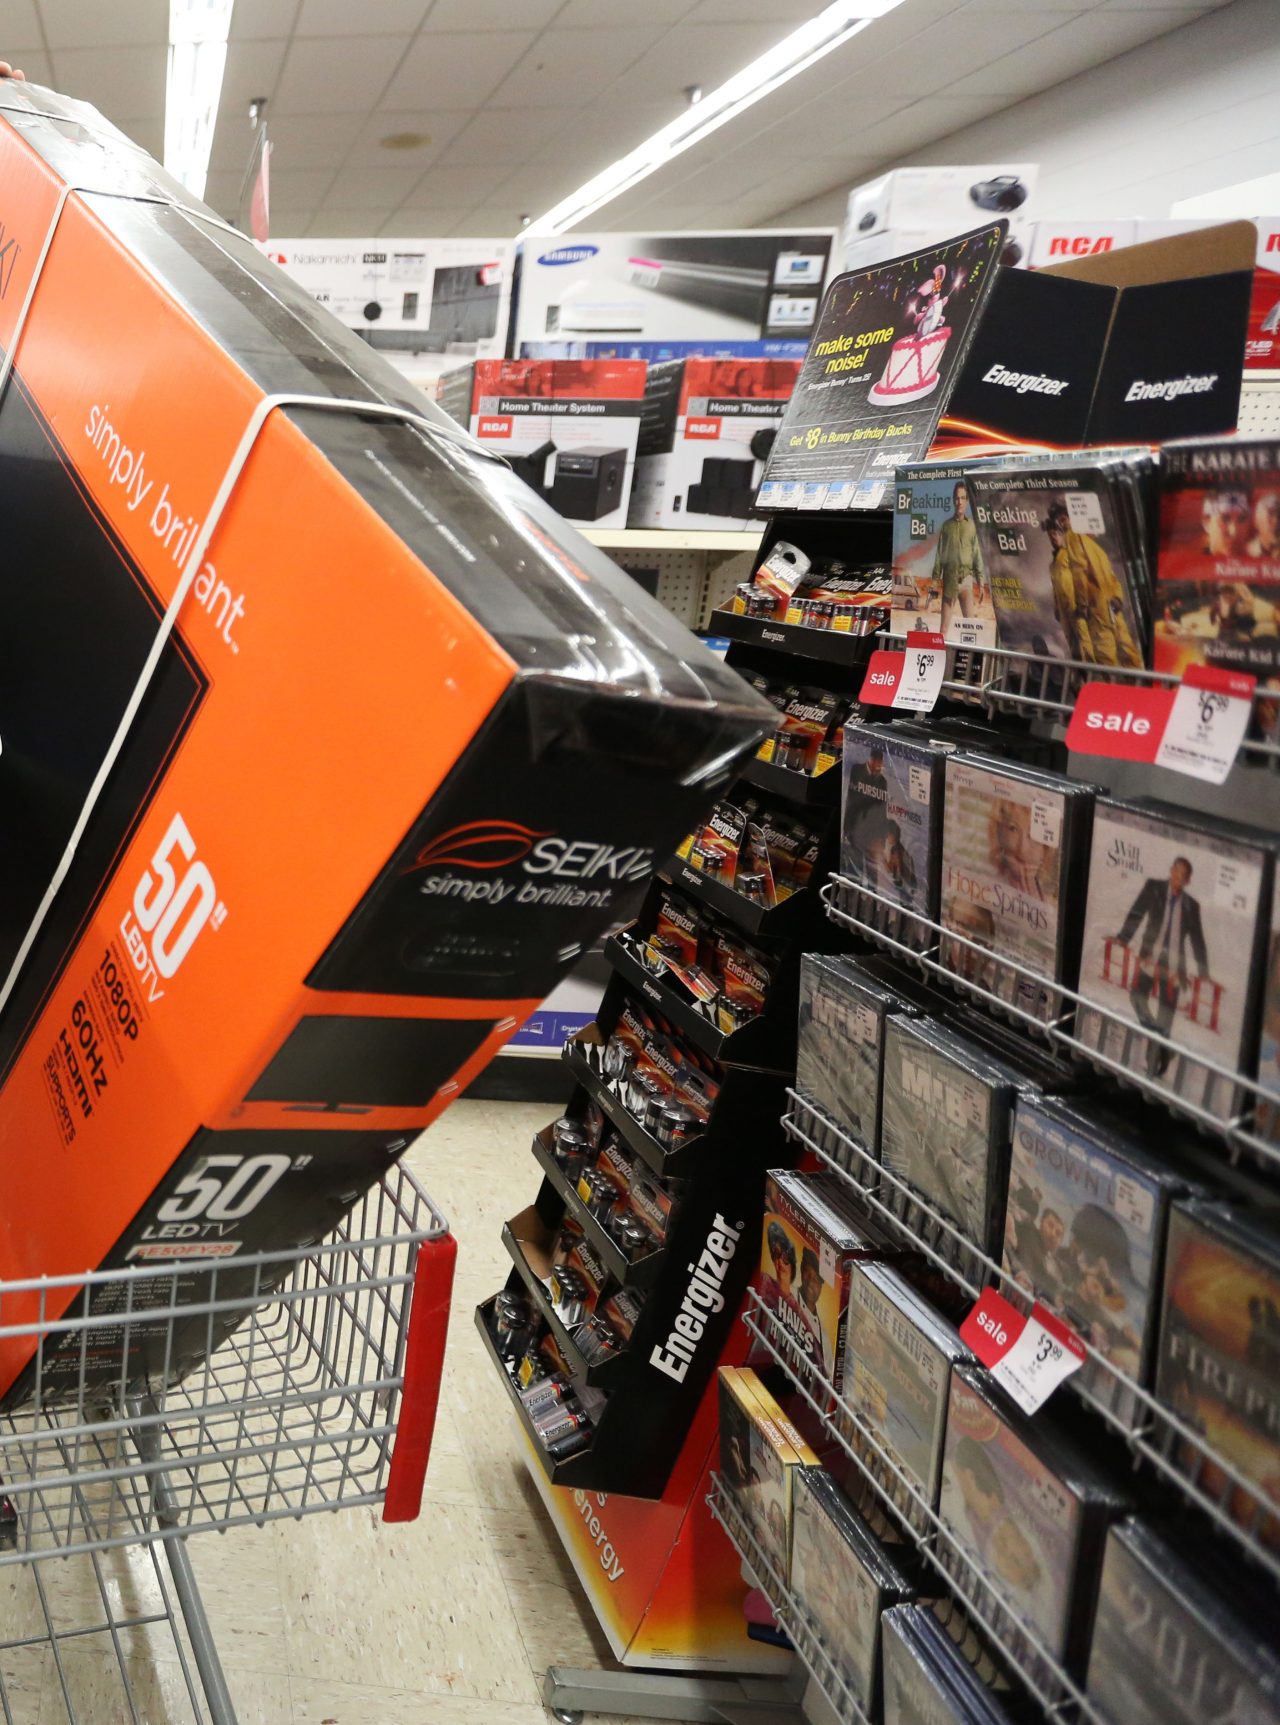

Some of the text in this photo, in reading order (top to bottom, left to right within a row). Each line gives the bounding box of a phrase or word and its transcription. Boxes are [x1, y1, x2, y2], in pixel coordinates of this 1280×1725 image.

[545, 248, 593, 261] SAMSUNG
[1049, 237, 1114, 255] RCA
[293, 253, 357, 264] Nakamichi
[815, 333, 853, 357] make
[853, 326, 895, 348] some
[825, 348, 870, 374] noise!
[982, 363, 1069, 396] Energizer
[1124, 373, 1218, 402] Energizer
[501, 402, 606, 414] Home Theater System
[710, 403, 779, 413] Home Theater
[481, 422, 509, 433] RCA
[688, 423, 717, 434] RCA
[790, 424, 913, 449] Get $8 in Bunny Birthday Bucks
[872, 450, 913, 469] Energizer
[1192, 451, 1269, 472] KARATE
[908, 470, 962, 481] The Complete First
[975, 479, 1079, 492] The Complete Third Season
[898, 492, 951, 512] Breaking
[84, 404, 245, 645] simply brilant
[911, 519, 935, 535] Bad
[977, 506, 1040, 528] Breaking
[998, 534, 1027, 552] Bad
[766, 553, 801, 584] Energizer
[822, 577, 866, 591] Energizer
[863, 576, 892, 594] Energ
[761, 628, 786, 643] Energizer
[870, 671, 896, 686] sale
[785, 699, 830, 722] Energizer
[1086, 711, 1151, 735] sale
[858, 782, 888, 802] PURSUIT
[709, 813, 740, 841] Energizer
[522, 838, 643, 880] SEIKI
[682, 867, 704, 886] Energizer
[421, 872, 612, 908] simply brilliant
[947, 866, 1048, 931] Hope Springs
[661, 902, 696, 933] Energizer
[726, 957, 766, 993] Energizer
[101, 950, 140, 1042] 1080P
[642, 981, 662, 1002] Energizer
[72, 1000, 109, 1096] 60Hz
[644, 1041, 679, 1078] Energizer
[46, 1057, 77, 1143] SUPPORTS
[1019, 1129, 1099, 1193] GROWN
[631, 1183, 665, 1223] Energizer
[780, 1193, 806, 1228] TYLER
[576, 1241, 603, 1283] Energizer
[613, 1291, 639, 1326] Energiz
[649, 1212, 742, 1384] Energizer
[779, 1296, 814, 1354] HAVES
[976, 1310, 1009, 1346] sale
[529, 1389, 554, 1407] Energizer
[545, 1421, 571, 1439] Energizer
[574, 1488, 625, 1582] energy
